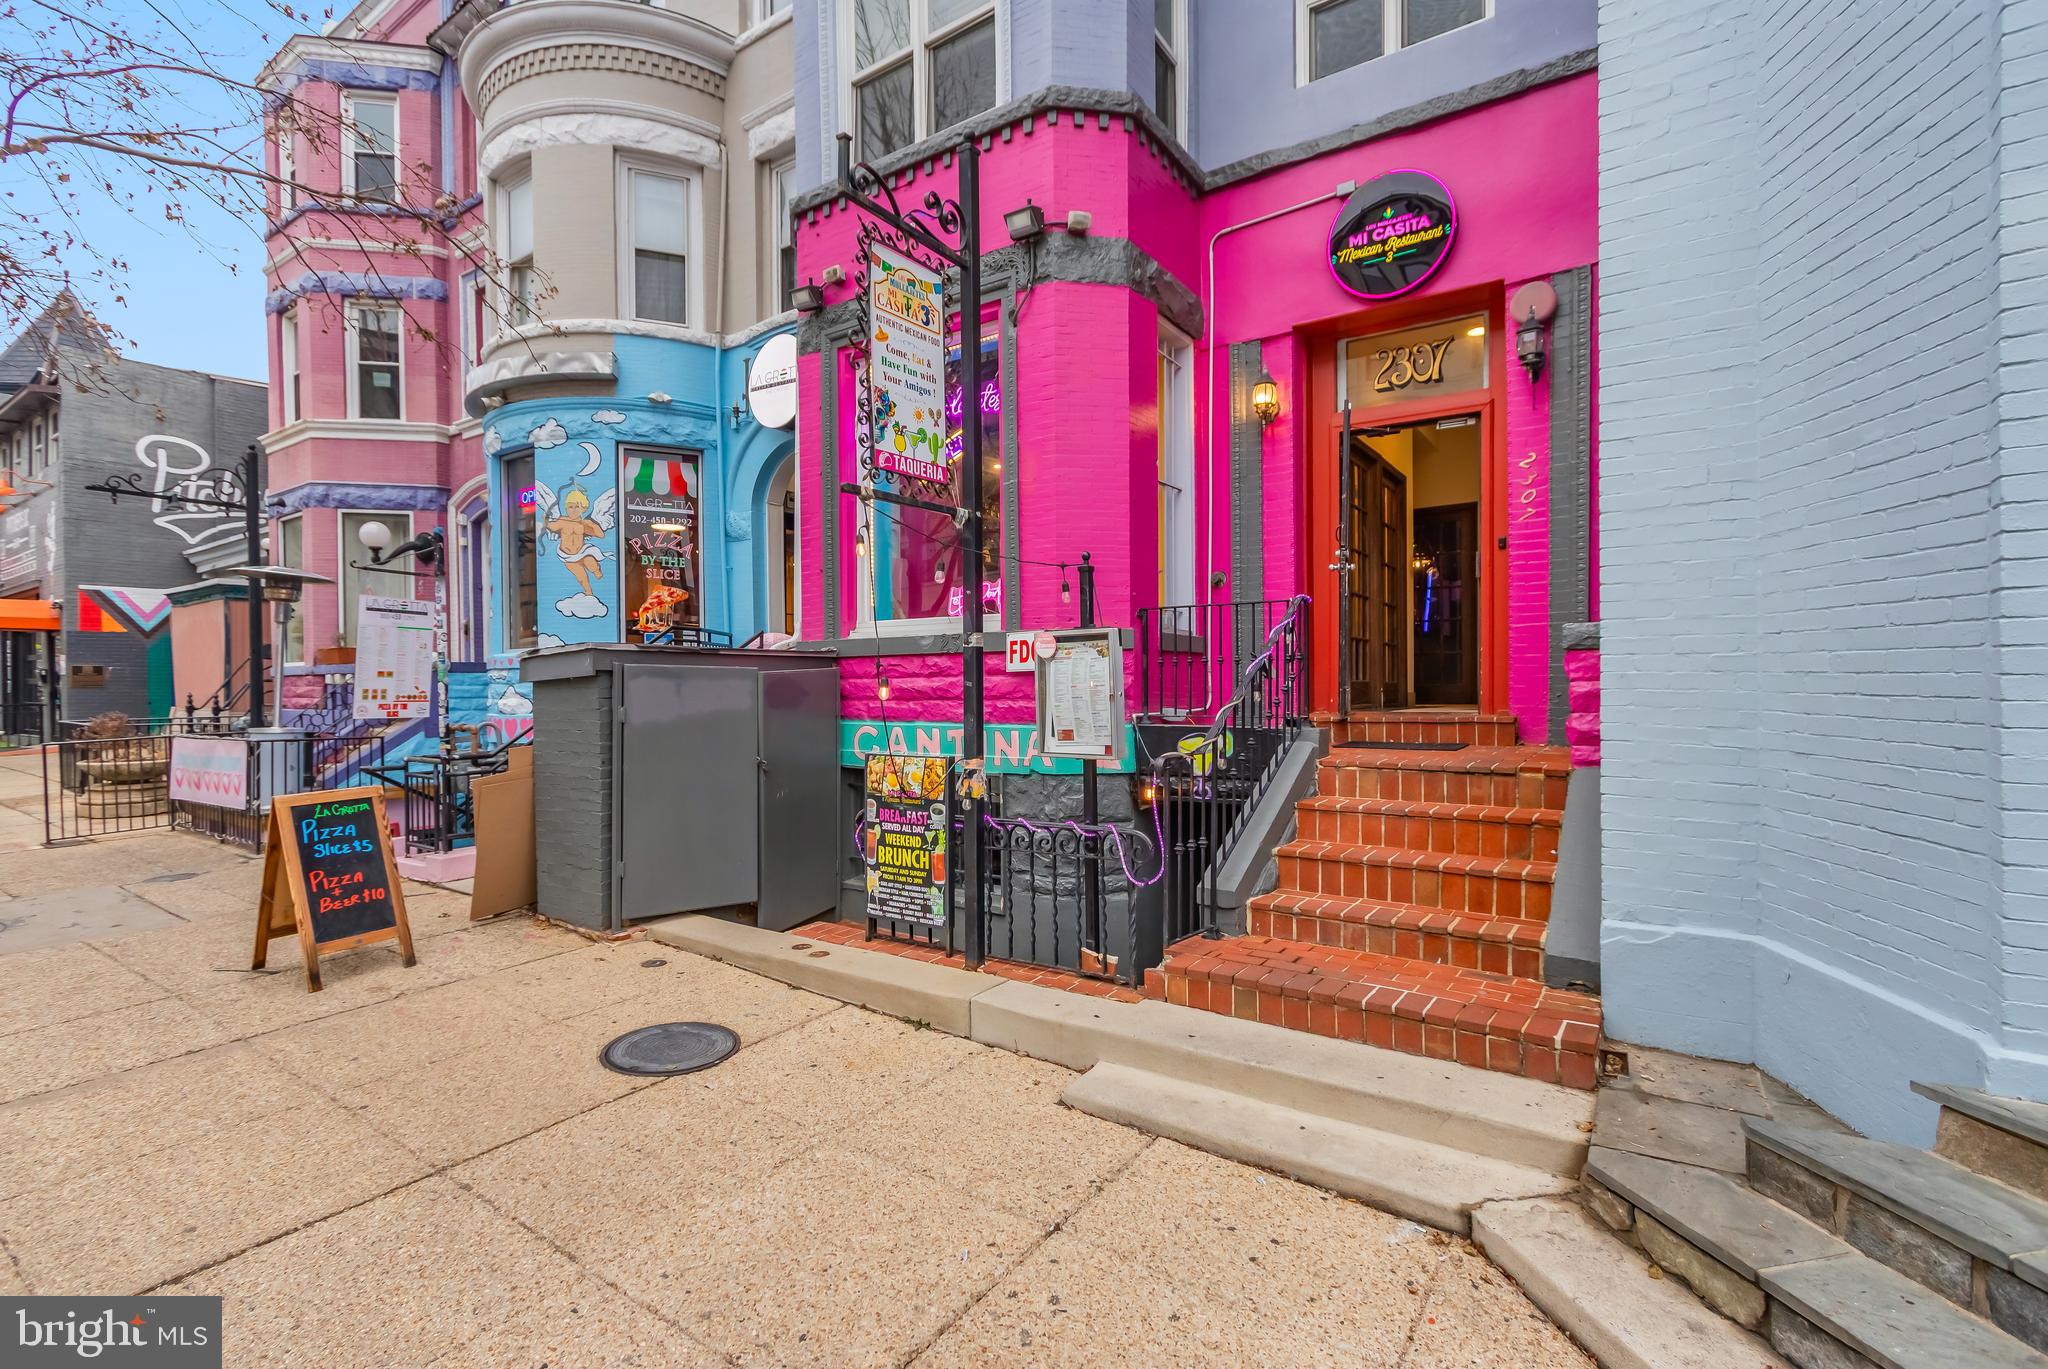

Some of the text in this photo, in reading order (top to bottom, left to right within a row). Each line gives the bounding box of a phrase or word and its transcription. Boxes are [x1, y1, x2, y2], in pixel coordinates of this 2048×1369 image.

[1349, 214, 1432, 248] MI CASITA
[1337, 224, 1444, 264] Mexican Restaurant
[1385, 251, 1393, 263] 3
[888, 288, 897, 299] MI
[920, 304, 930, 327] 3
[876, 314, 940, 347] AUTHENTIC MEXICAN FOOD
[886, 343, 932, 369] Come, Eat &
[1374, 336, 1455, 393] 2307
[881, 355, 937, 385] Have Fun with
[883, 371, 903, 386] Your
[904, 380, 932, 396] Amigos
[894, 455, 943, 482] TAQUERIA
[1518, 452, 1537, 521] 2307
[627, 497, 643, 507] LA
[630, 514, 692, 526] 202-450-1292
[629, 531, 694, 559] PIZZA
[641, 554, 686, 567] BY THE
[645, 568, 681, 580] SLICE
[853, 725, 1052, 768] CANTNA
[302, 819, 357, 844] PIZZA
[881, 822, 925, 834] SERVED ALL DAY
[884, 832, 922, 848] WEEKEND
[352, 839, 373, 853] $5
[878, 845, 929, 870] BRUNCH
[308, 870, 364, 893] PIZZA
[909, 869, 928, 877] SUNDAY
[319, 888, 385, 913] BEER $10
